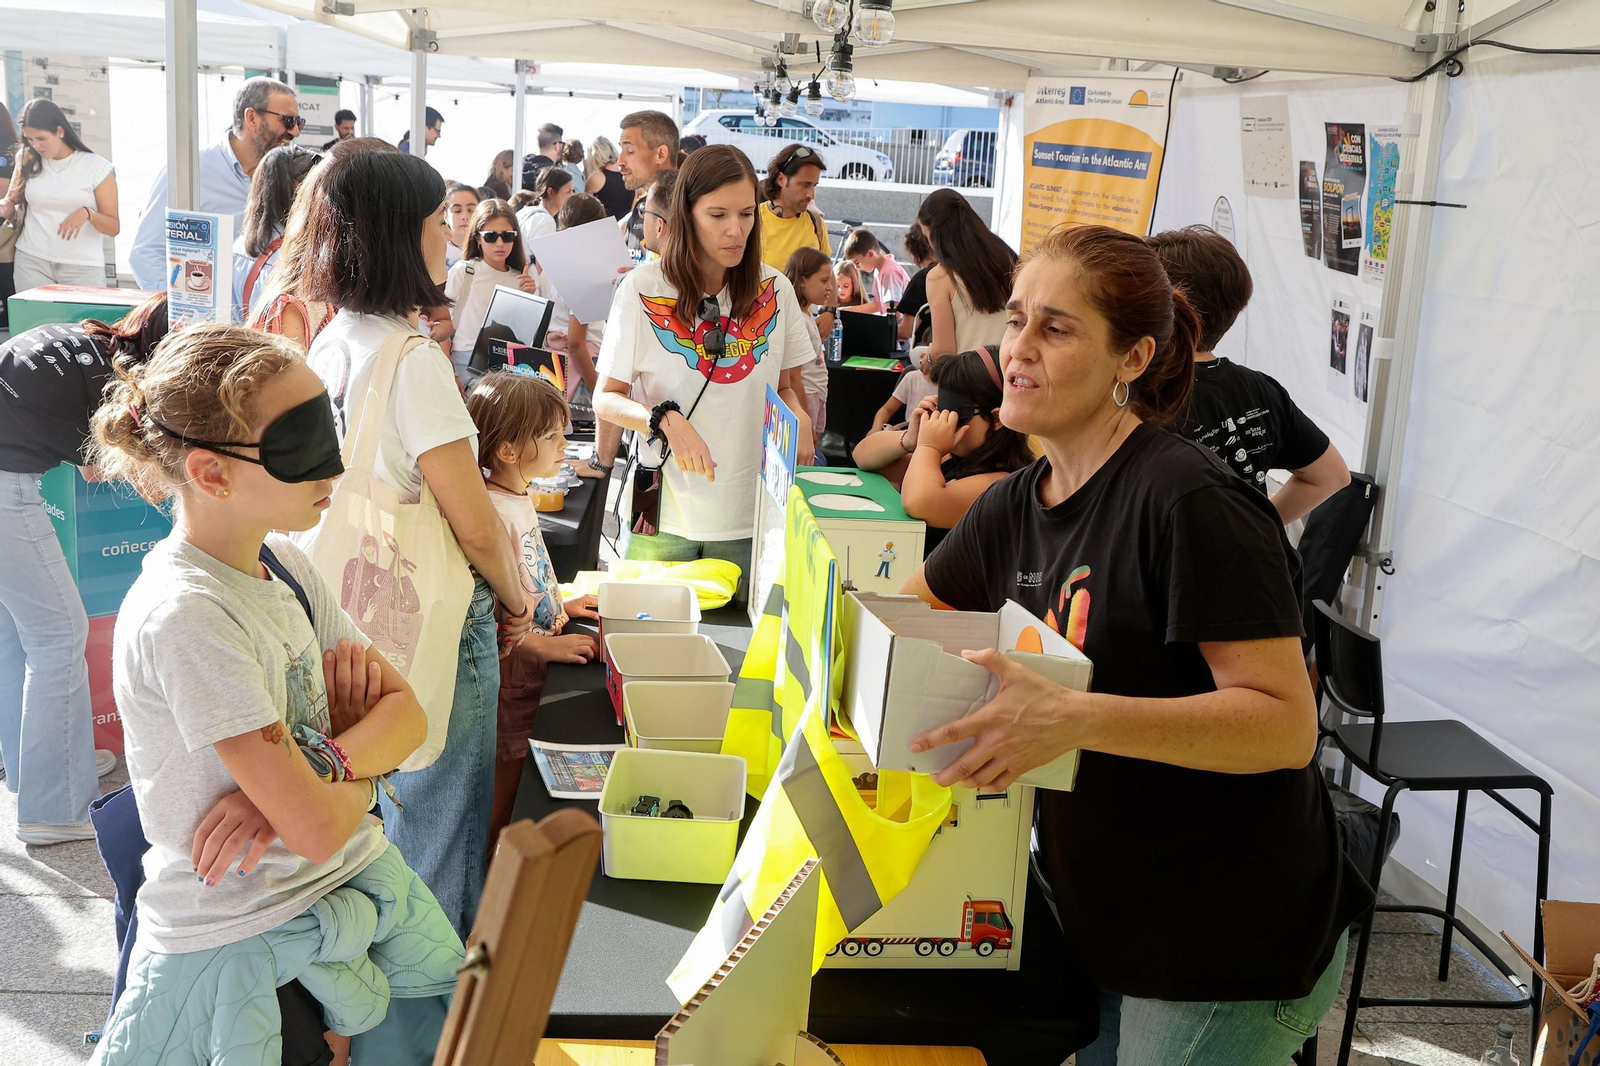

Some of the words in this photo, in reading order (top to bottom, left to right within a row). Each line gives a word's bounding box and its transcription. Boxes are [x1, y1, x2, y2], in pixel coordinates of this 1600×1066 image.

[1036, 86, 1066, 97] Interreg
[1034, 149, 1055, 161] Sunset
[1055, 151, 1081, 163] Tourism
[1081, 153, 1090, 164] in
[1091, 153, 1102, 166] the
[1102, 155, 1133, 170] Atlantic
[1323, 182, 1345, 196] SOLPOR
